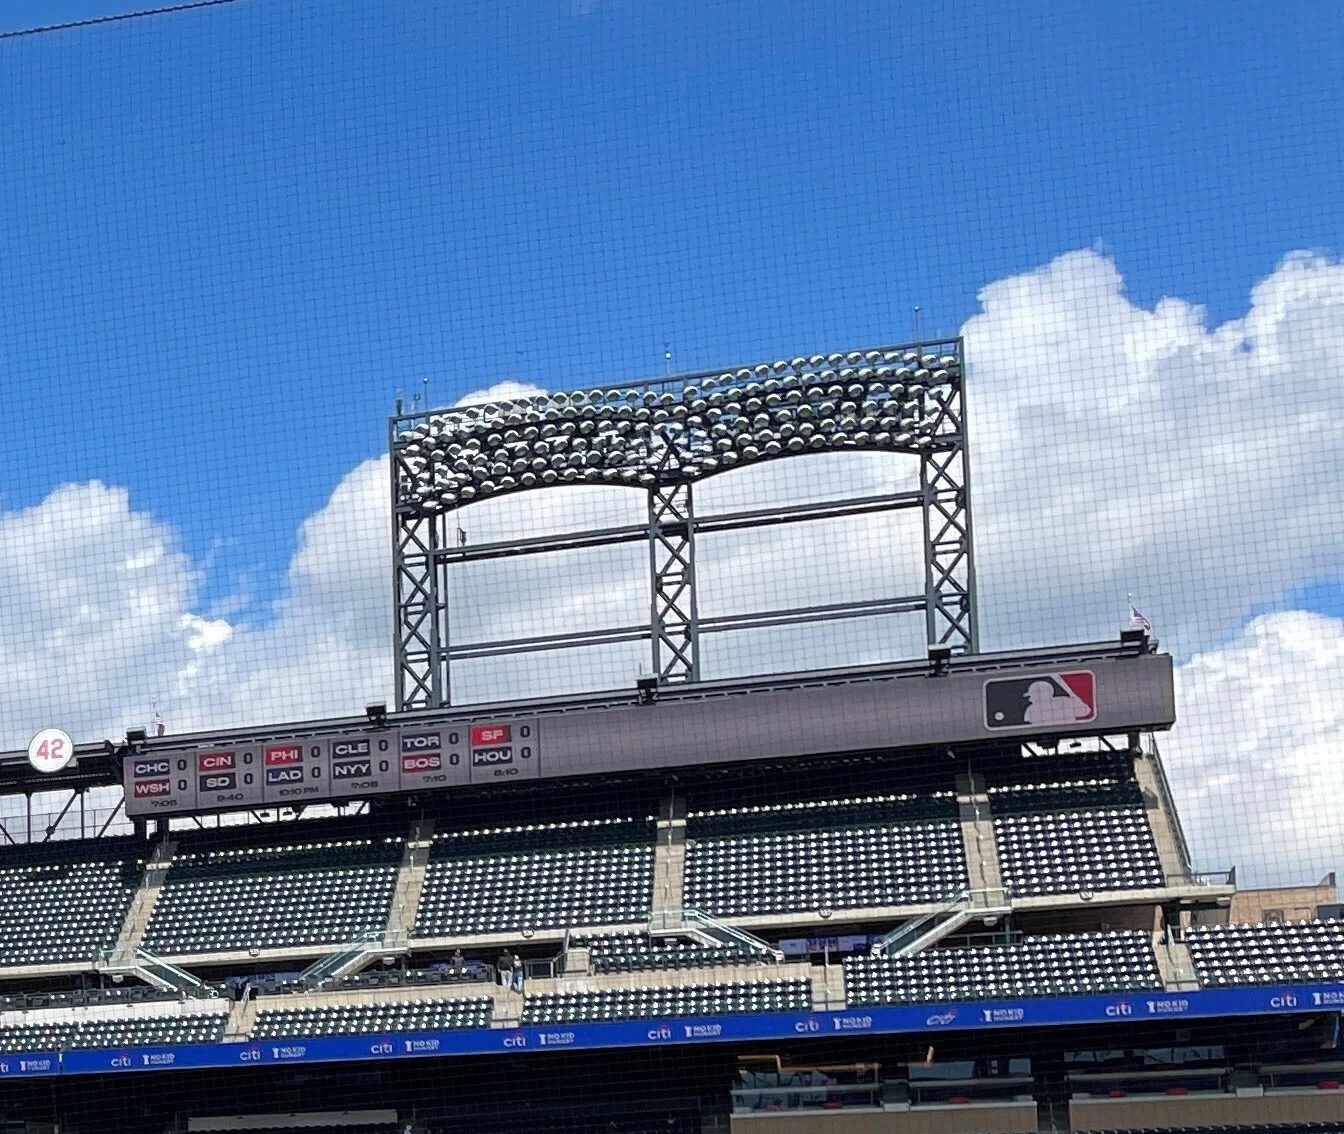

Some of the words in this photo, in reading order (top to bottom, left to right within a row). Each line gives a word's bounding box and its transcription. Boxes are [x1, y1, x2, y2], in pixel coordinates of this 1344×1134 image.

[404, 736, 440, 748] TOR
[449, 733, 459, 744] 0
[481, 730, 503, 740] SF
[521, 726, 530, 737] 0
[36, 738, 66, 760] 42
[271, 750, 298, 761] PHI
[311, 746, 320, 757] 0
[335, 743, 368, 754] CLE
[379, 740, 388, 751] 0
[204, 755, 232, 767] CIN
[244, 753, 253, 764] 0
[404, 757, 440, 770] BOS
[450, 754, 459, 765] 0
[474, 750, 511, 763] HOU
[521, 747, 530, 758] 0
[136, 762, 169, 774] CHC
[178, 760, 187, 770] 0
[268, 770, 302, 782] LAD
[312, 767, 321, 778] 0
[335, 763, 369, 776] NYY
[380, 761, 388, 772] 0
[136, 782, 170, 794] WSH
[178, 780, 187, 790] 0
[206, 777, 230, 788] SD
[244, 773, 253, 784] 0
[304, 786, 319, 794] PM
